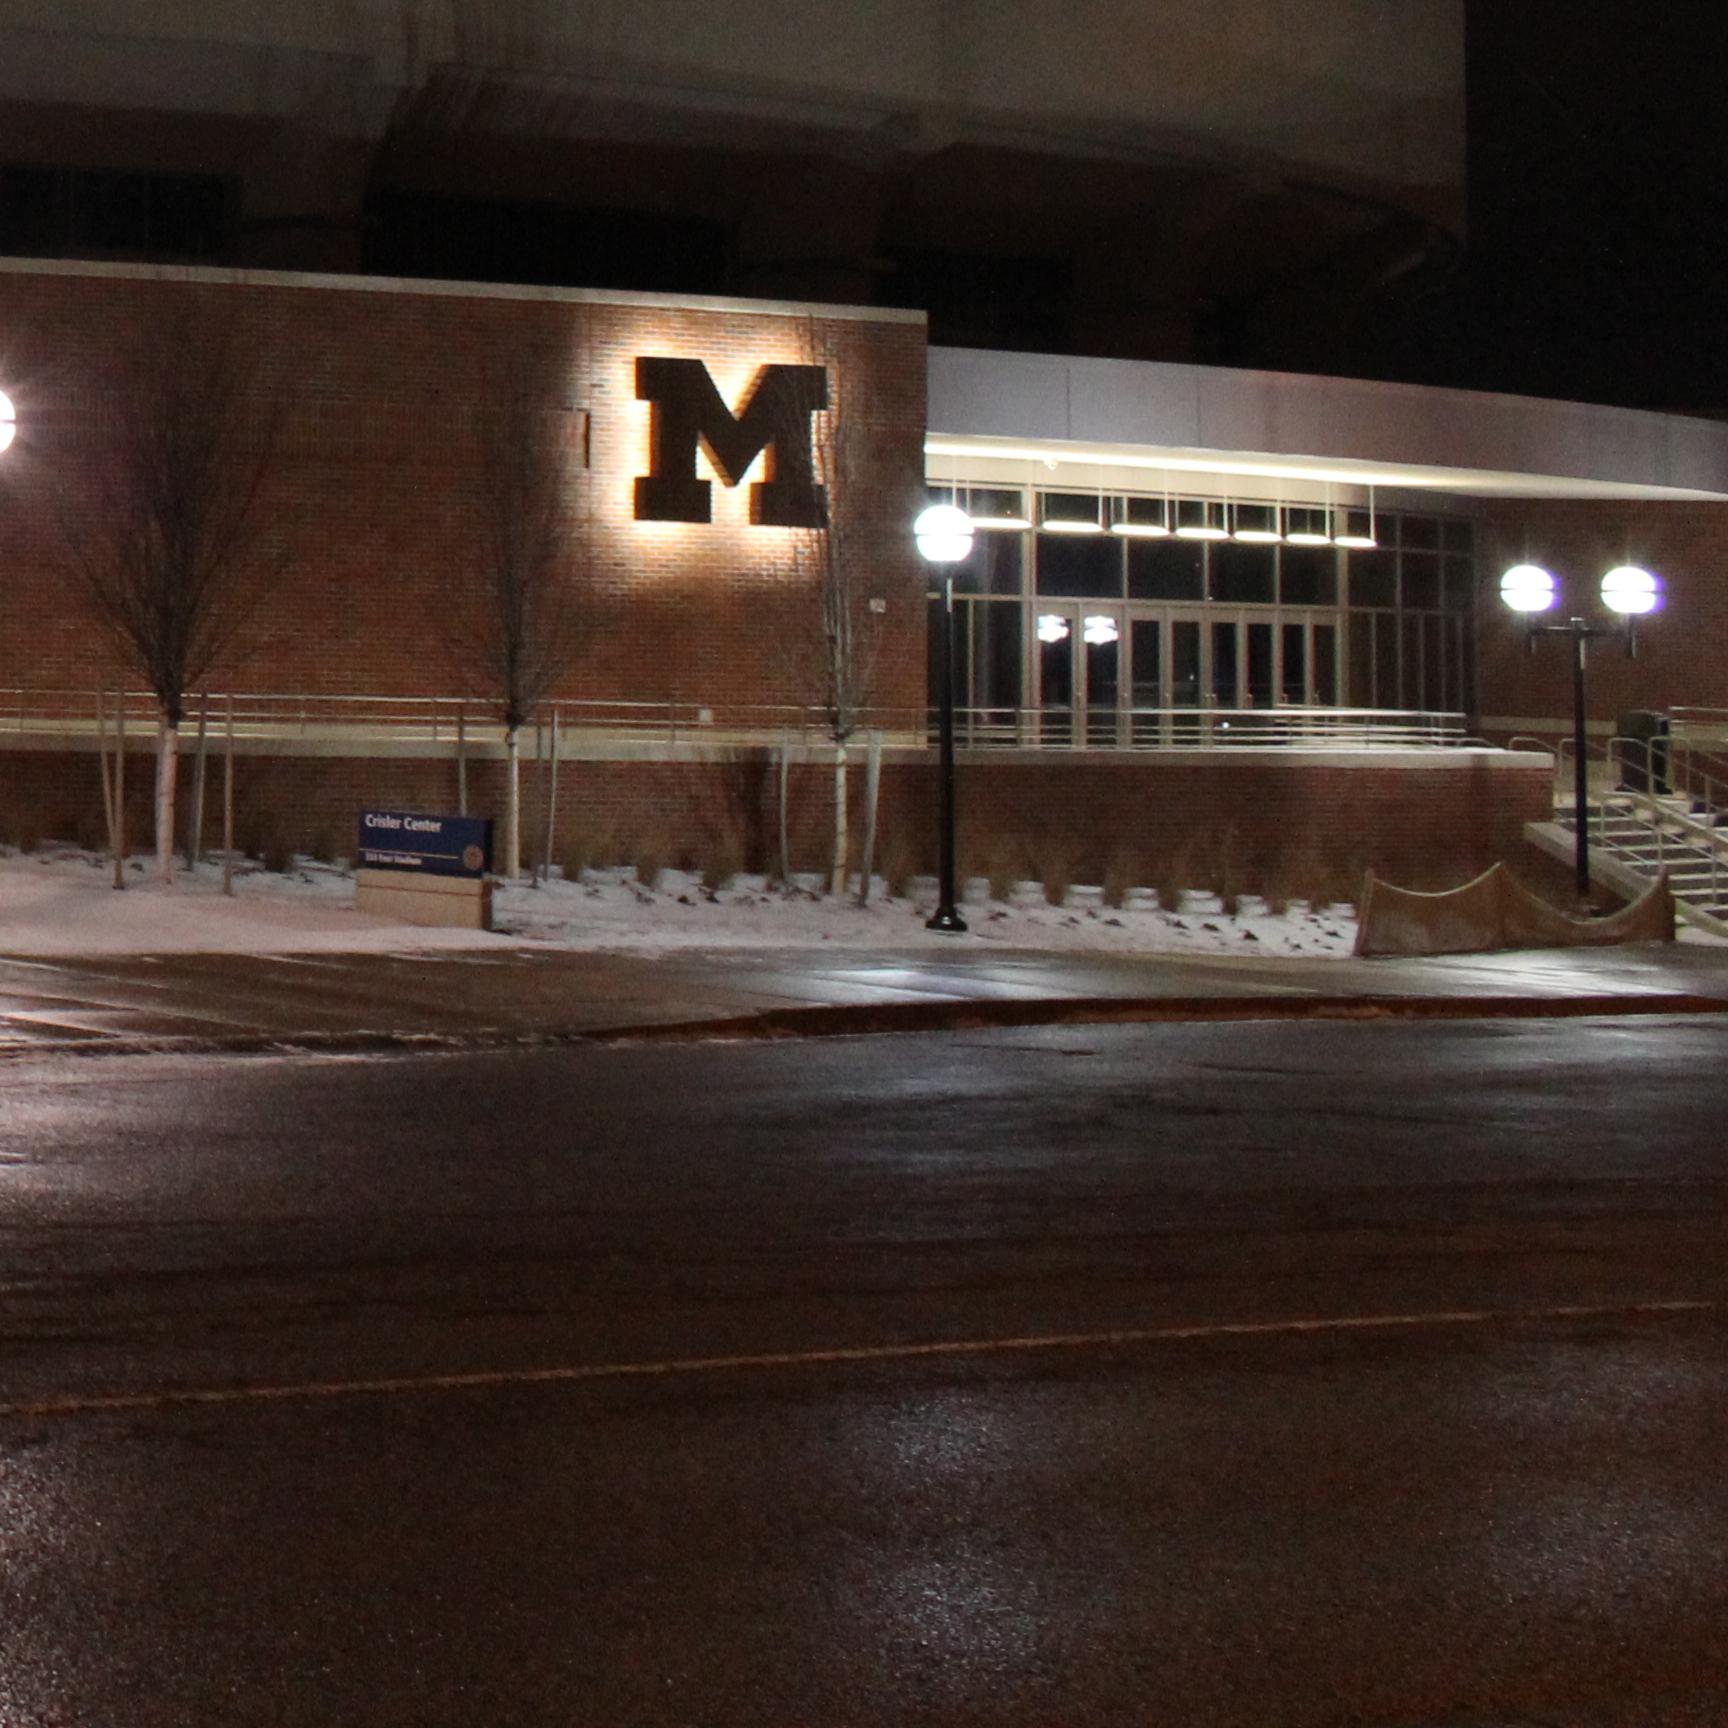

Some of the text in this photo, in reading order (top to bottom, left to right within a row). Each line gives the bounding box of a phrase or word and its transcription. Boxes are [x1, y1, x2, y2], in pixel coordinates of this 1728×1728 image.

[633, 356, 829, 529] M
[365, 814, 442, 832] Crisler Center
